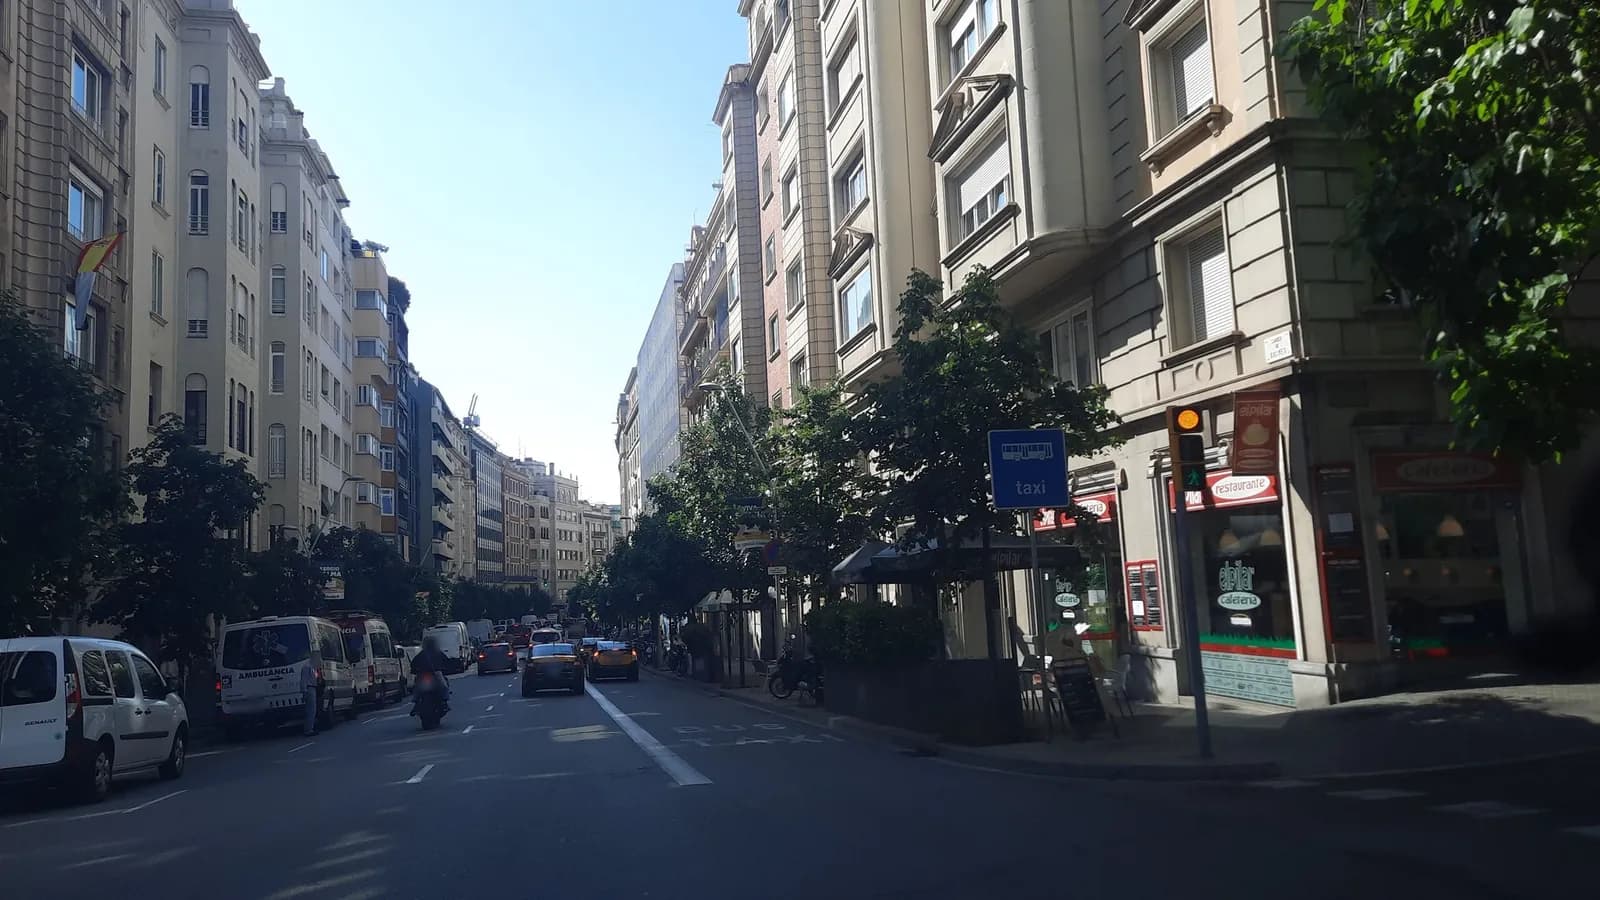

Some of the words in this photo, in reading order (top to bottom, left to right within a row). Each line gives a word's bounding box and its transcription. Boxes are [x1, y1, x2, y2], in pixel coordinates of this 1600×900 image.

[1016, 480, 1046, 495] taxi
[1215, 478, 1266, 494] restaurante
[24, 718, 57, 726] RENAULT
